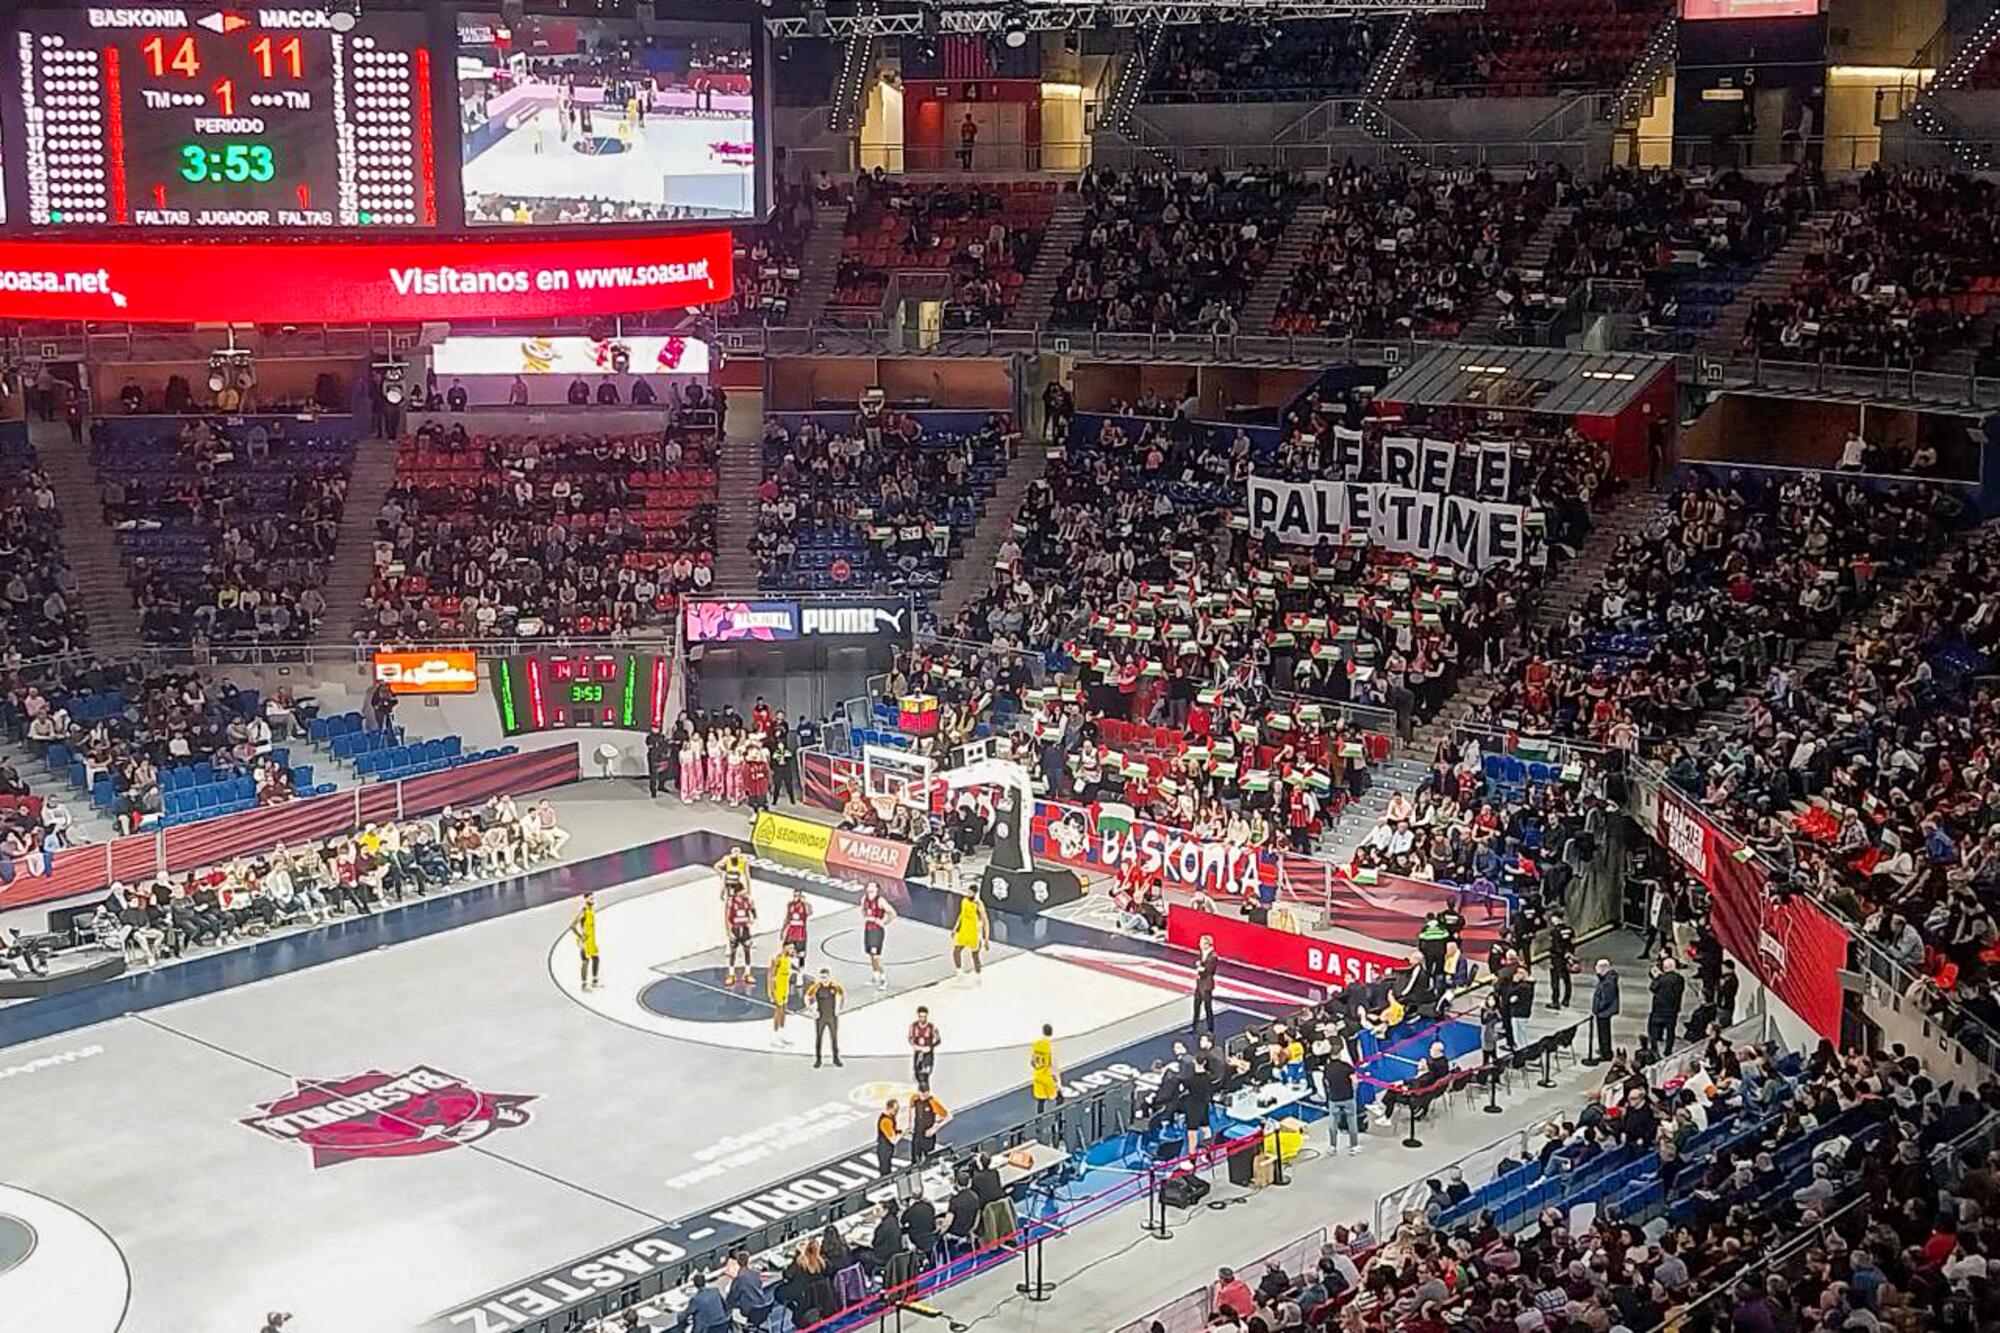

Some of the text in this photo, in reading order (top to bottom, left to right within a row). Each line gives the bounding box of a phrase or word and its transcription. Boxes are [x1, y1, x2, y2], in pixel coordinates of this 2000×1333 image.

[90, 9, 188, 28] BASKONIA
[259, 9, 332, 28] MACCA
[144, 37, 200, 77] 14
[252, 37, 304, 78] 11
[1743, 68, 1754, 86] 5
[143, 91, 171, 109] TM
[216, 79, 235, 115] 1
[286, 91, 310, 109] TM
[194, 118, 265, 133] PERIODO
[180, 145, 275, 182] 3:53
[154, 184, 166, 208] 1
[297, 184, 309, 209] 1
[135, 211, 332, 227] FALTAS JUGADOR FALTAS
[0, 268, 111, 294] oasa.net
[389, 257, 709, 296] Visítanos en www.soasa.net
[802, 607, 879, 635] PUMA
[572, 686, 603, 702] 3:53
[849, 840, 899, 865] AMBAR
[450, 1238, 686, 1333] GASTEIZ
